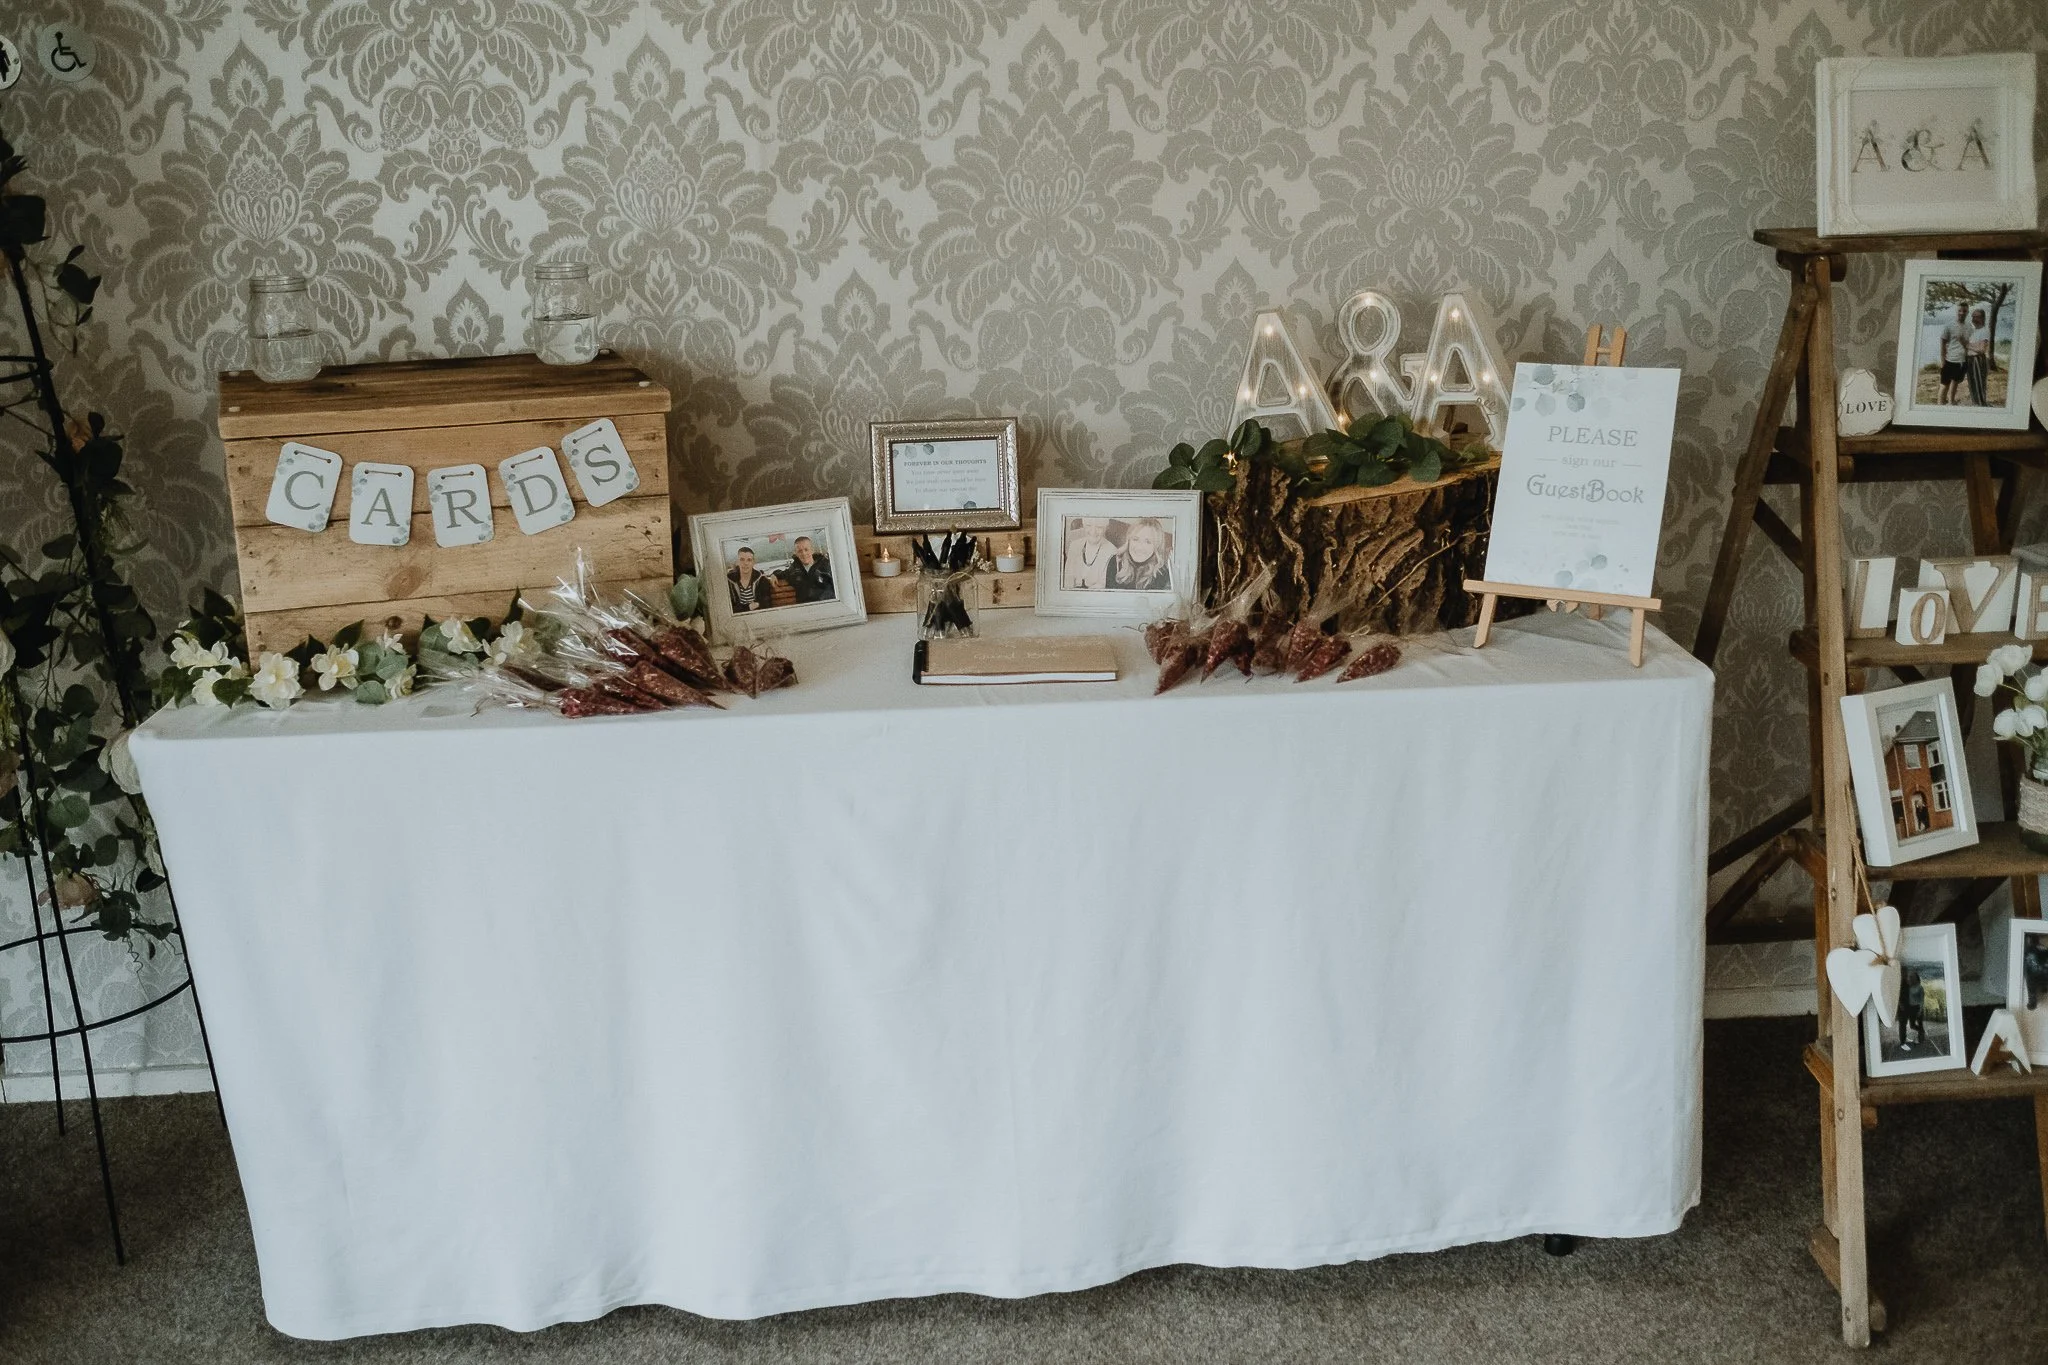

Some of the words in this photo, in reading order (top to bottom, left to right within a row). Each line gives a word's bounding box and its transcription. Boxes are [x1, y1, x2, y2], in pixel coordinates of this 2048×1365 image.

[1845, 400, 1887, 415] LOVE
[1547, 425, 1638, 447] PLEASE
[1562, 454, 1589, 468] sign
[1593, 458, 1617, 468] our
